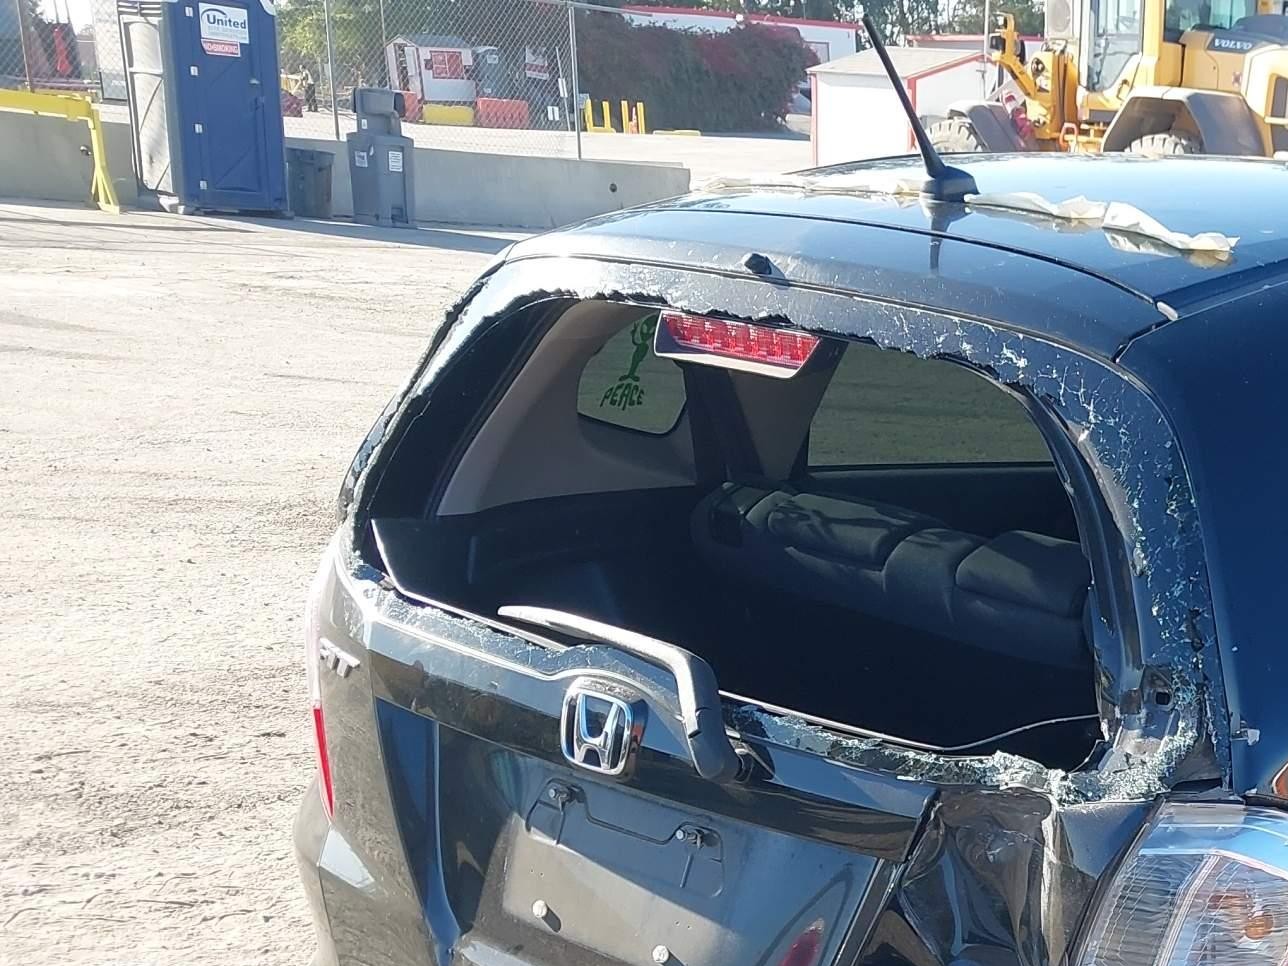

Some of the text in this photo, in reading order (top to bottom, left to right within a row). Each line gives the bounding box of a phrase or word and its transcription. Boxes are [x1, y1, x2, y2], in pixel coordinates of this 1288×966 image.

[206, 14, 246, 29] United
[1215, 38, 1252, 49] VOLVO
[599, 382, 646, 411] PEACE
